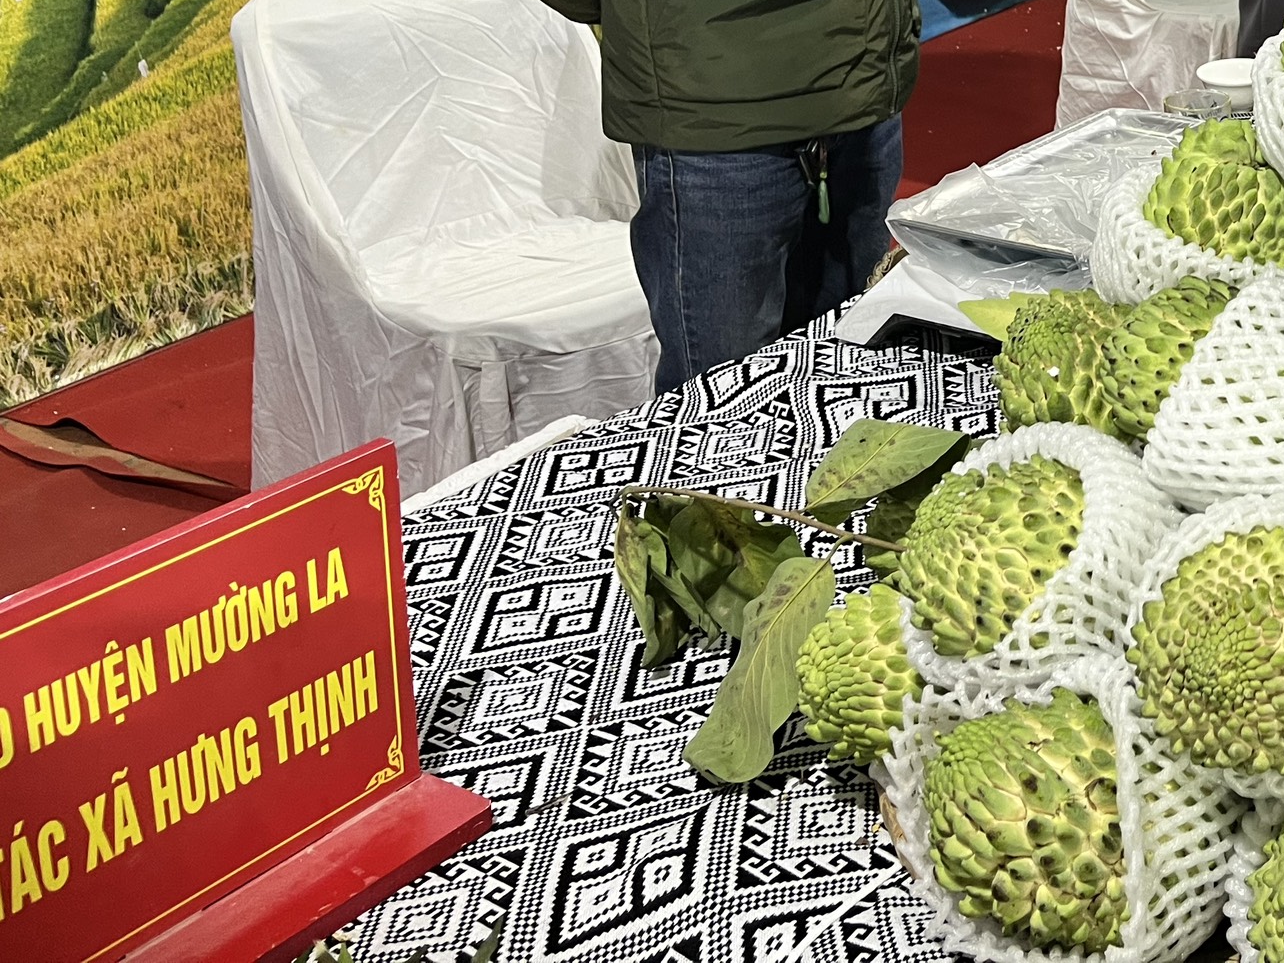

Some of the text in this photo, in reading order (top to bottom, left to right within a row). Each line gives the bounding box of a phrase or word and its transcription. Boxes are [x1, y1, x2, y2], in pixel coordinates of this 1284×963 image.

[23, 639, 158, 754] HUYỆN
[165, 570, 298, 683] MƯỜNG
[306, 547, 349, 614] LA
[78, 767, 144, 873] XÃ
[149, 716, 262, 833] HƯNG
[268, 650, 379, 765] THỊNH
